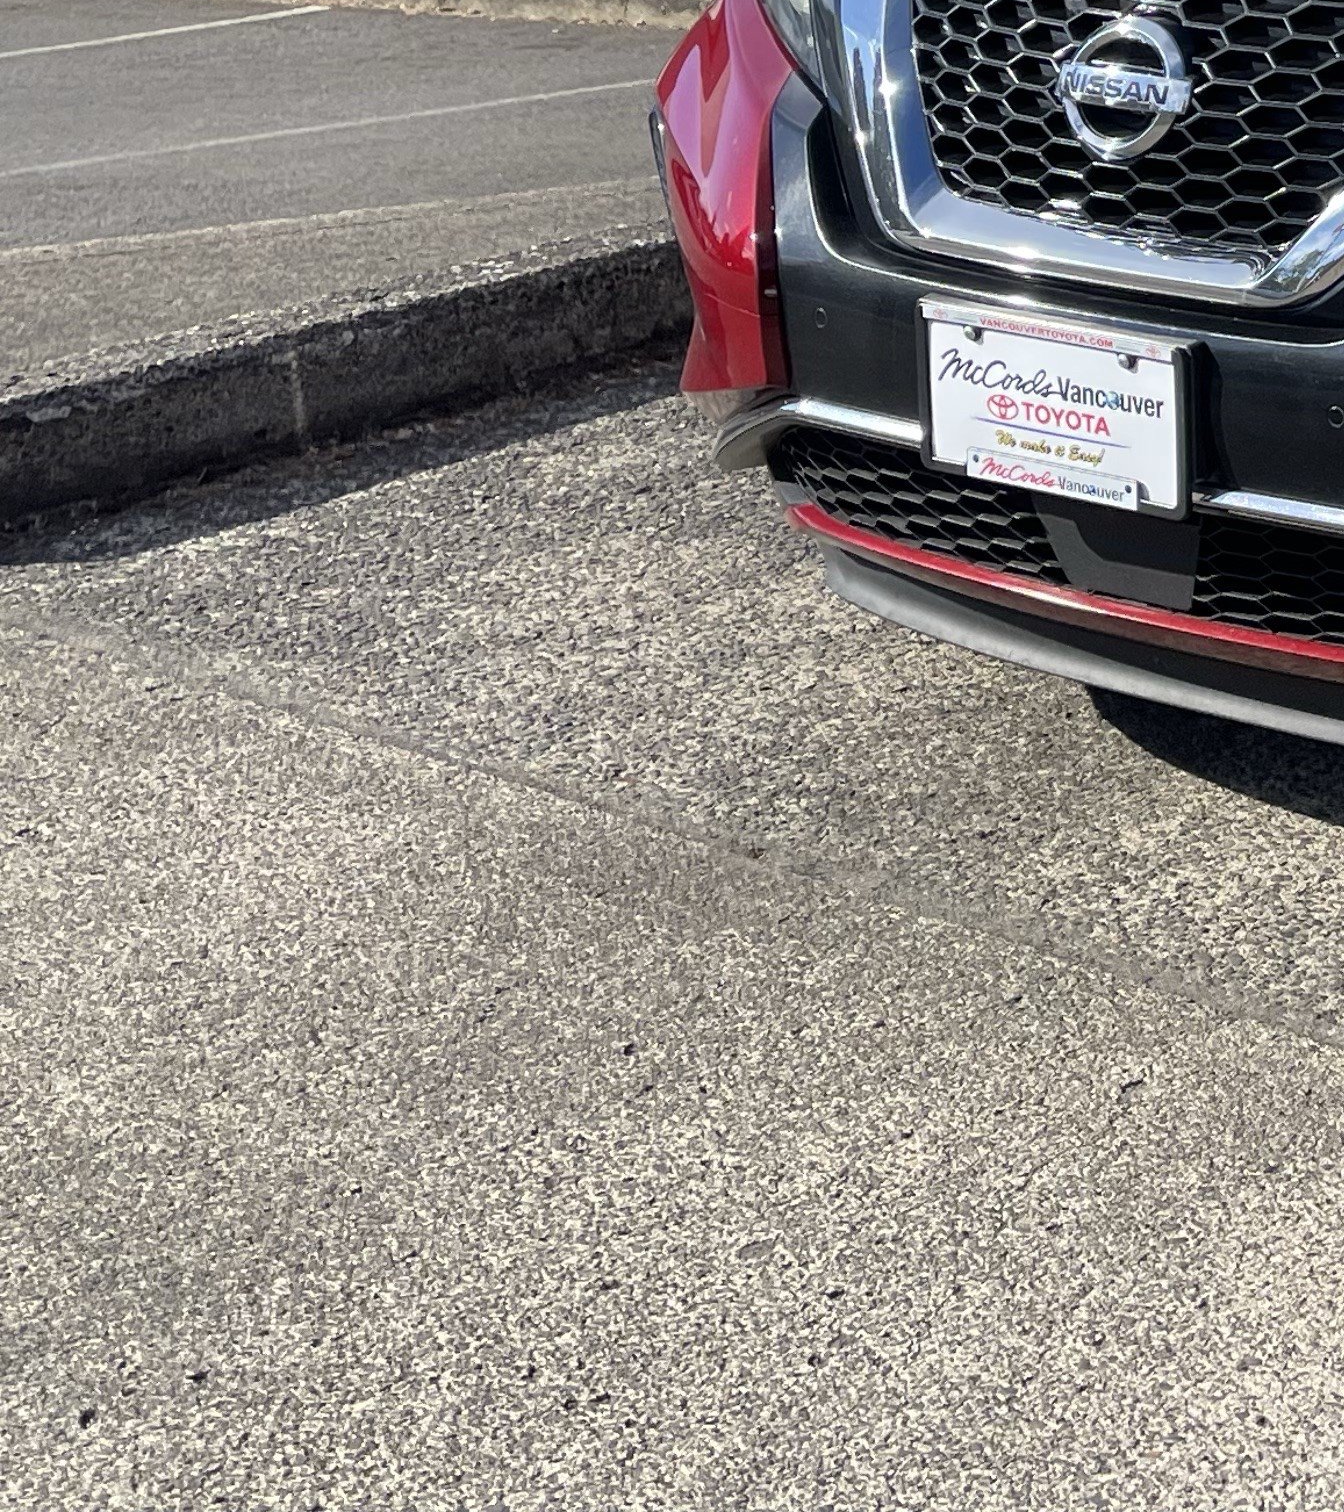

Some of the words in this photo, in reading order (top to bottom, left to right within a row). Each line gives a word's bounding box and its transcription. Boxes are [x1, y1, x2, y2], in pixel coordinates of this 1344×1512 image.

[1063, 70, 1170, 105] NISSAN
[980, 316, 1114, 348] VANCOUVERTOYOTA.COM
[1021, 401, 1112, 437] TOYOTA
[995, 429, 1017, 448] We
[980, 456, 1057, 488] McCords
[1057, 476, 1125, 503] Vancouver
